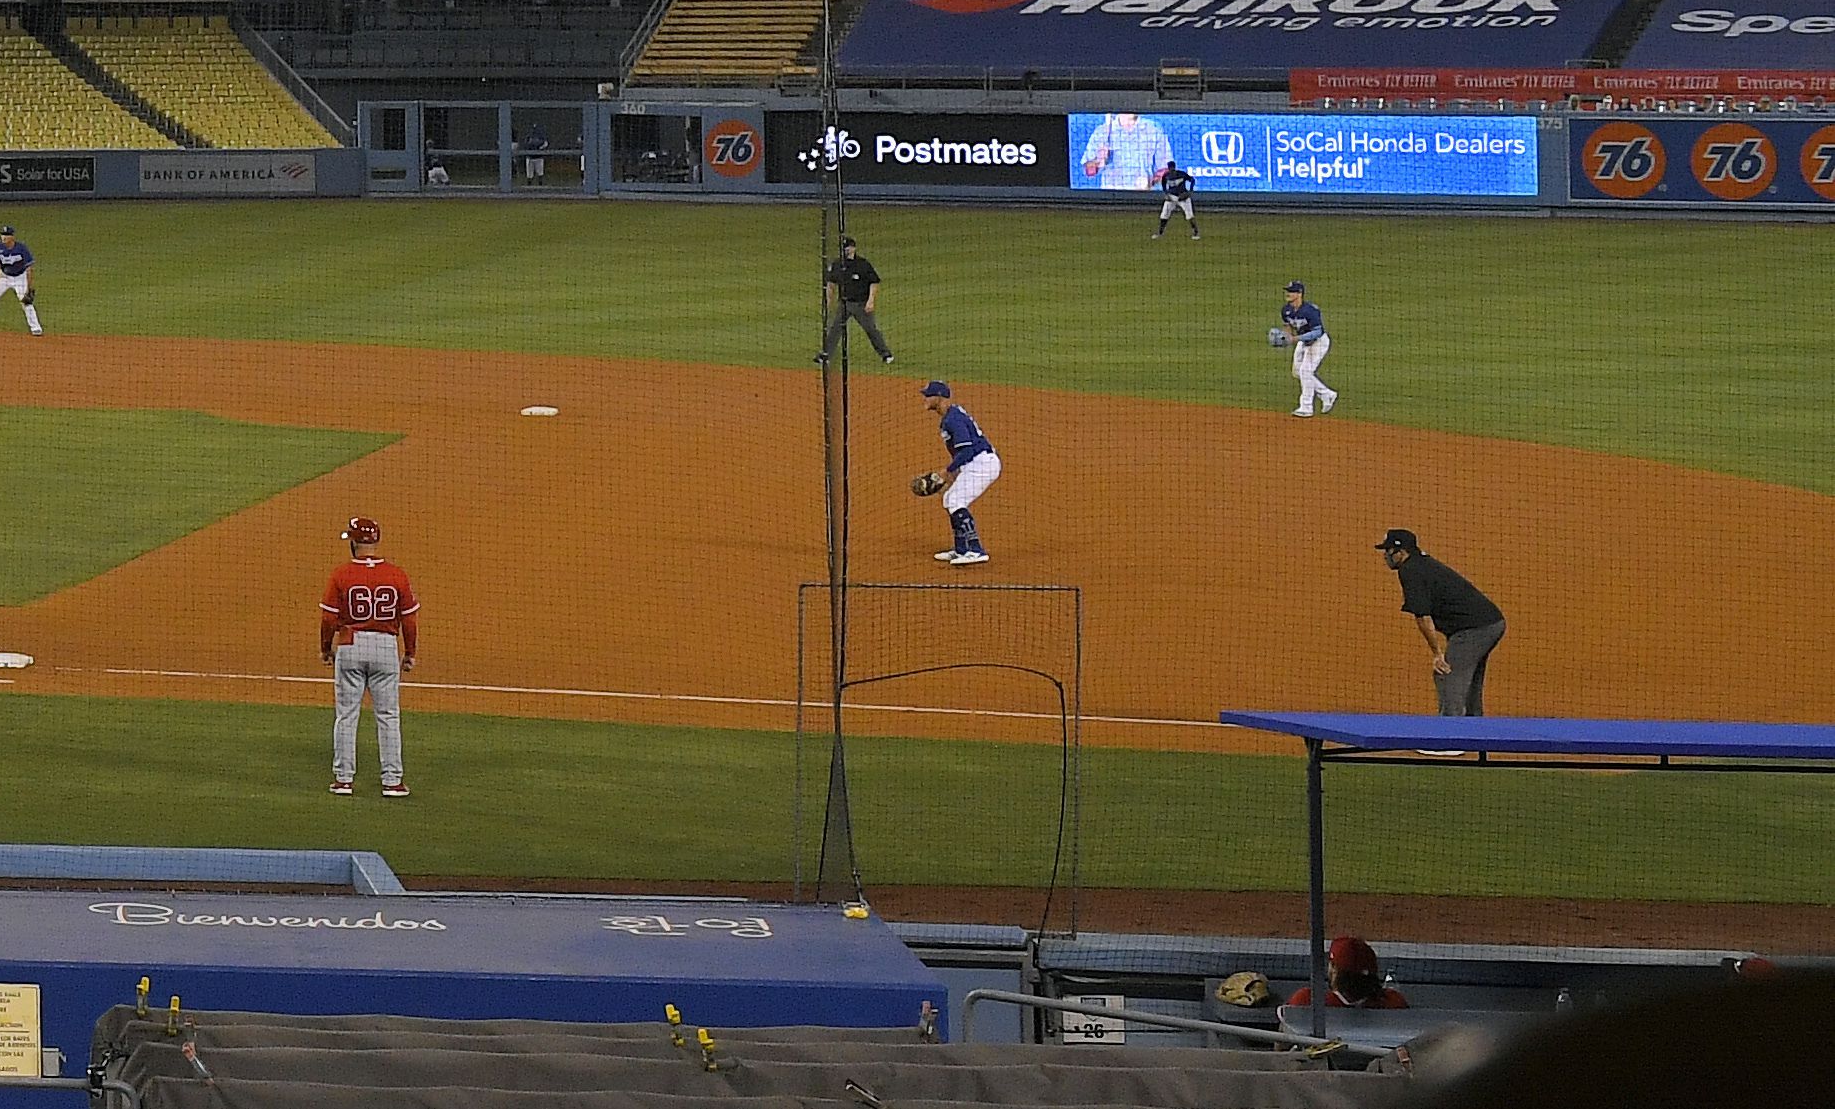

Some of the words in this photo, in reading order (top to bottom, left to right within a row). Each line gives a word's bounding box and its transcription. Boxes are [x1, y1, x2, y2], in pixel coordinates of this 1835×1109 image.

[1139, 12, 1321, 30] driving
[1332, 11, 1557, 29] emotion
[1671, 9, 1835, 37] Spe
[712, 133, 755, 164] 76
[875, 135, 1037, 167] Postmates
[1276, 130, 1343, 153] SoCal
[1350, 131, 1428, 154] Honda
[1435, 132, 1526, 154] Dealers
[16, 167, 45, 180] Solar
[46, 166, 63, 180] for
[64, 166, 91, 180] USA
[144, 169, 183, 180] BANK
[186, 170, 204, 180] OF
[209, 167, 276, 180] AMERICA
[1187, 166, 1261, 178] HONDA
[1593, 137, 1656, 181] 76
[1703, 138, 1767, 184] 76
[348, 585, 398, 621] 62
[88, 902, 447, 932] Bienvenidos
